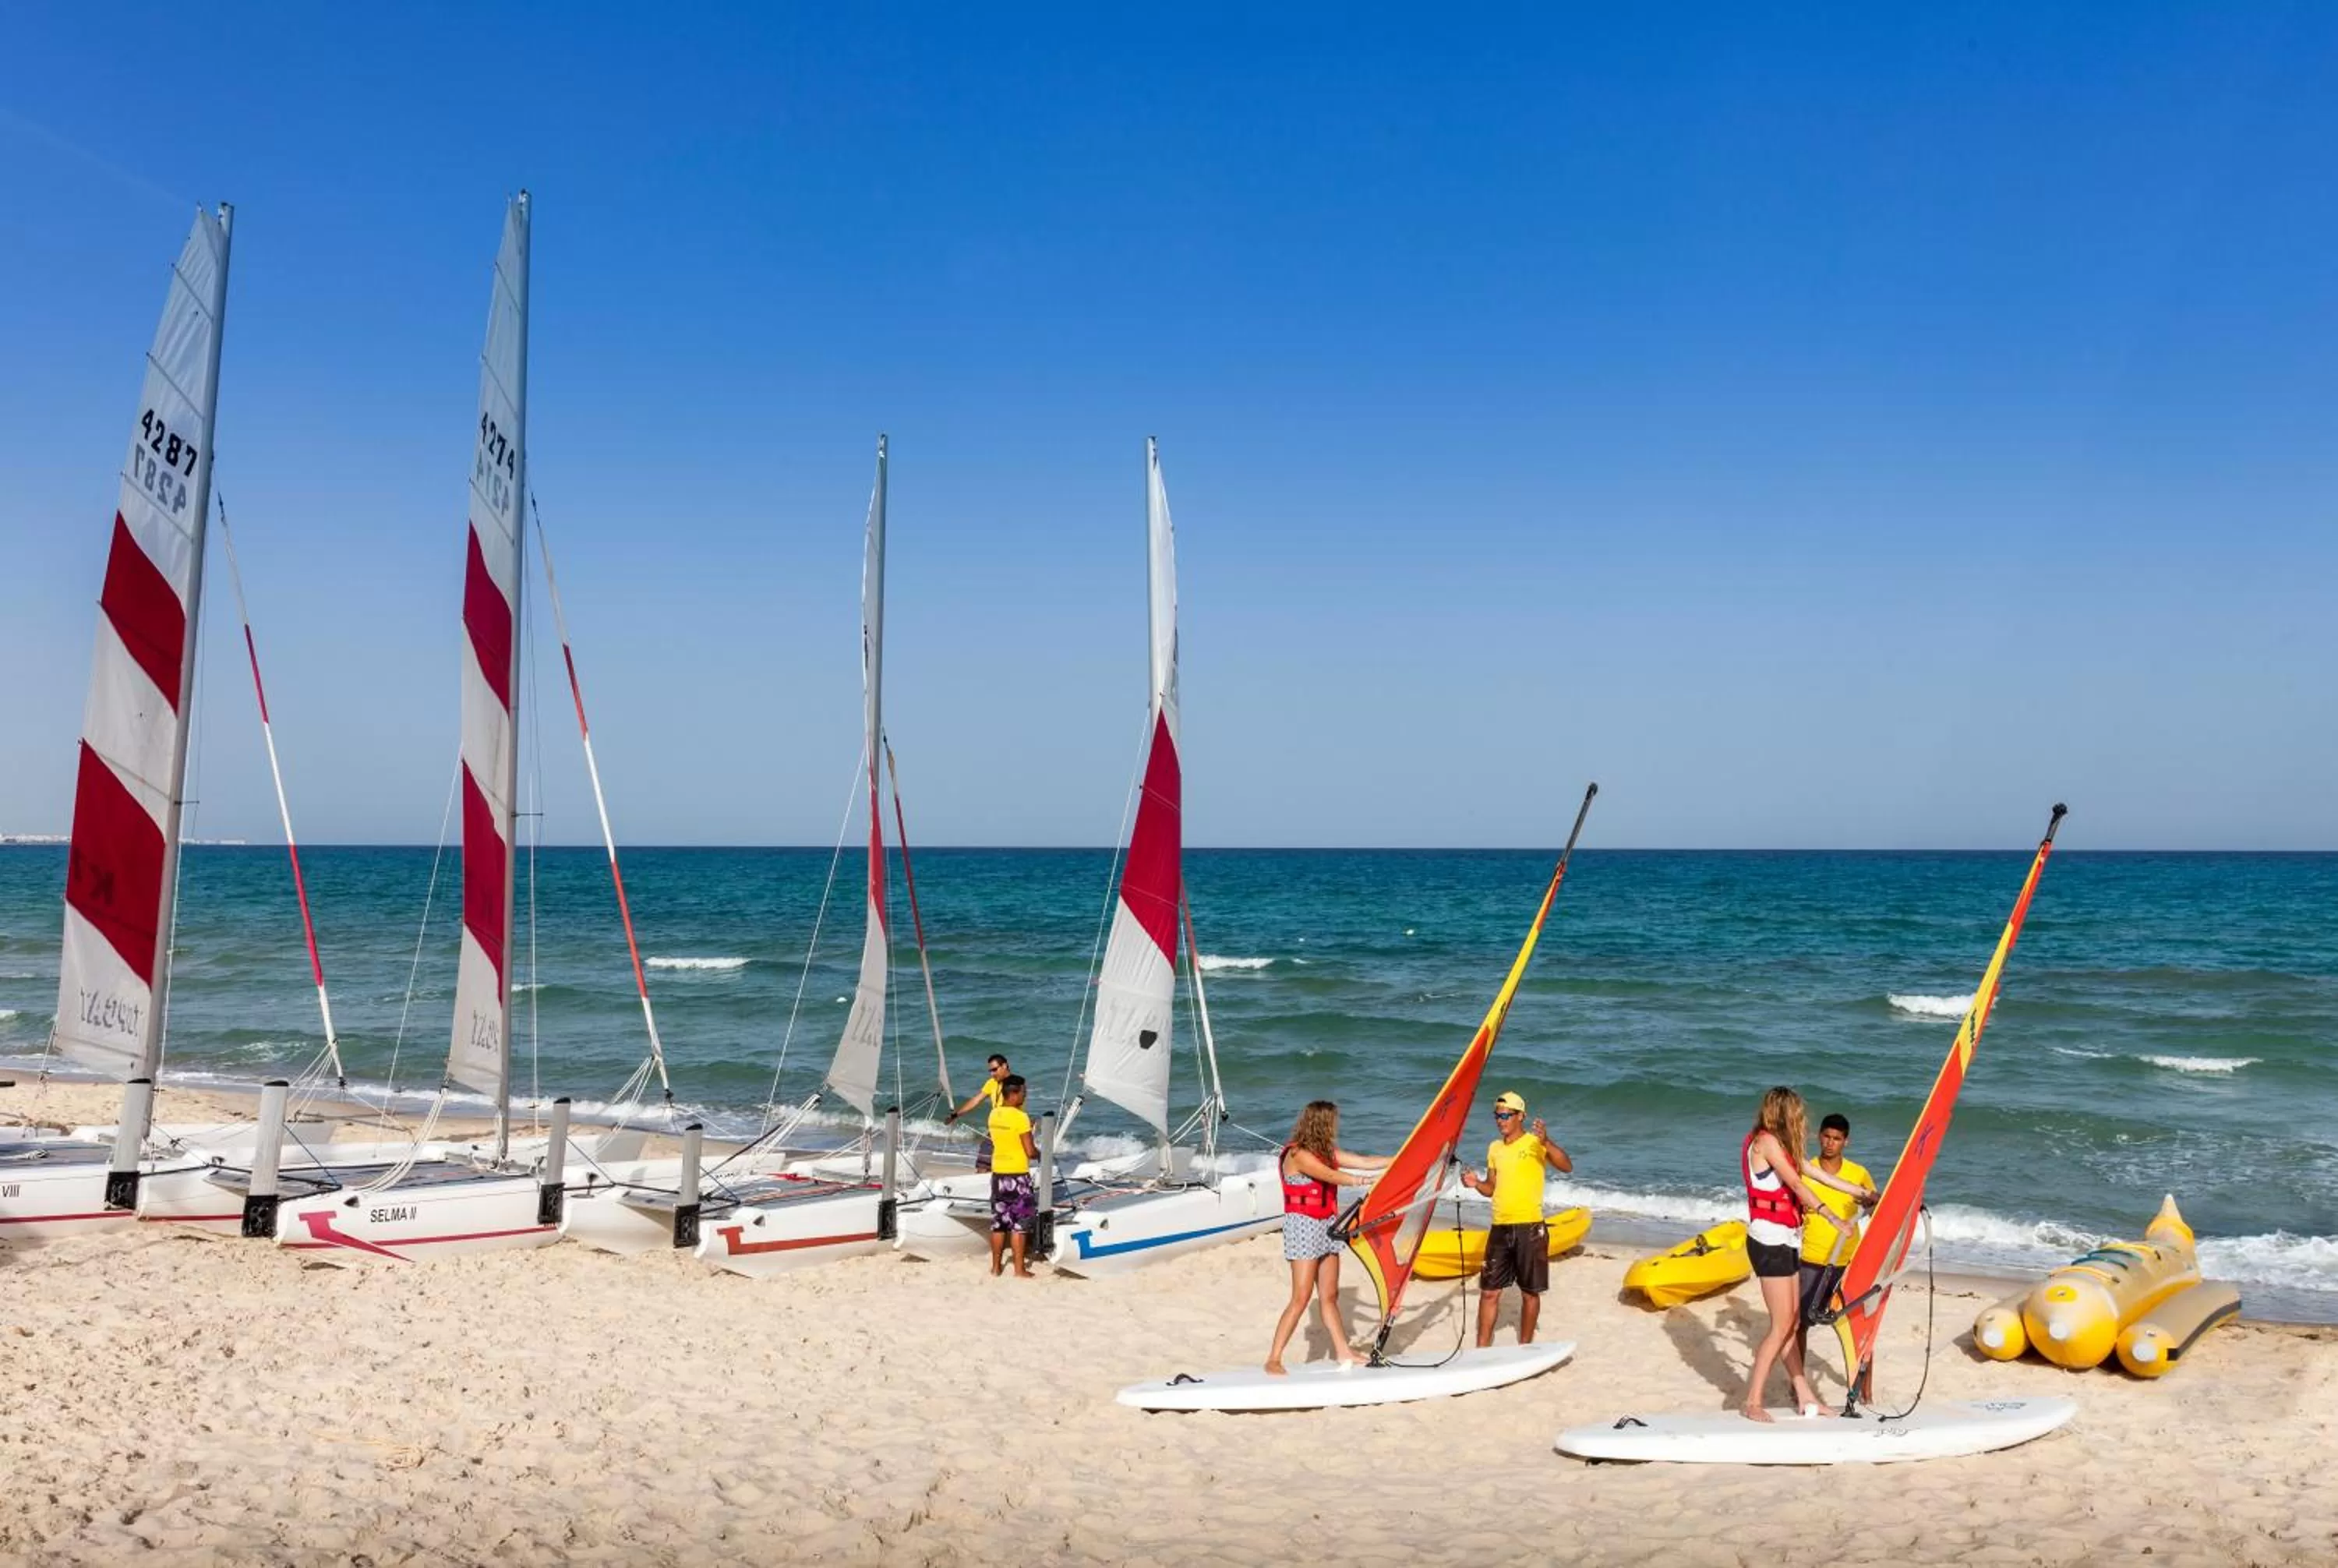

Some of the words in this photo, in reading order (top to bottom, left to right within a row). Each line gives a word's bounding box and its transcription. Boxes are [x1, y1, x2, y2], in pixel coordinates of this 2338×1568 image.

[141, 408, 197, 478] 4287
[481, 411, 515, 481] 4274
[2, 1185, 20, 1198] VIII
[370, 1207, 407, 1223] SELMA
